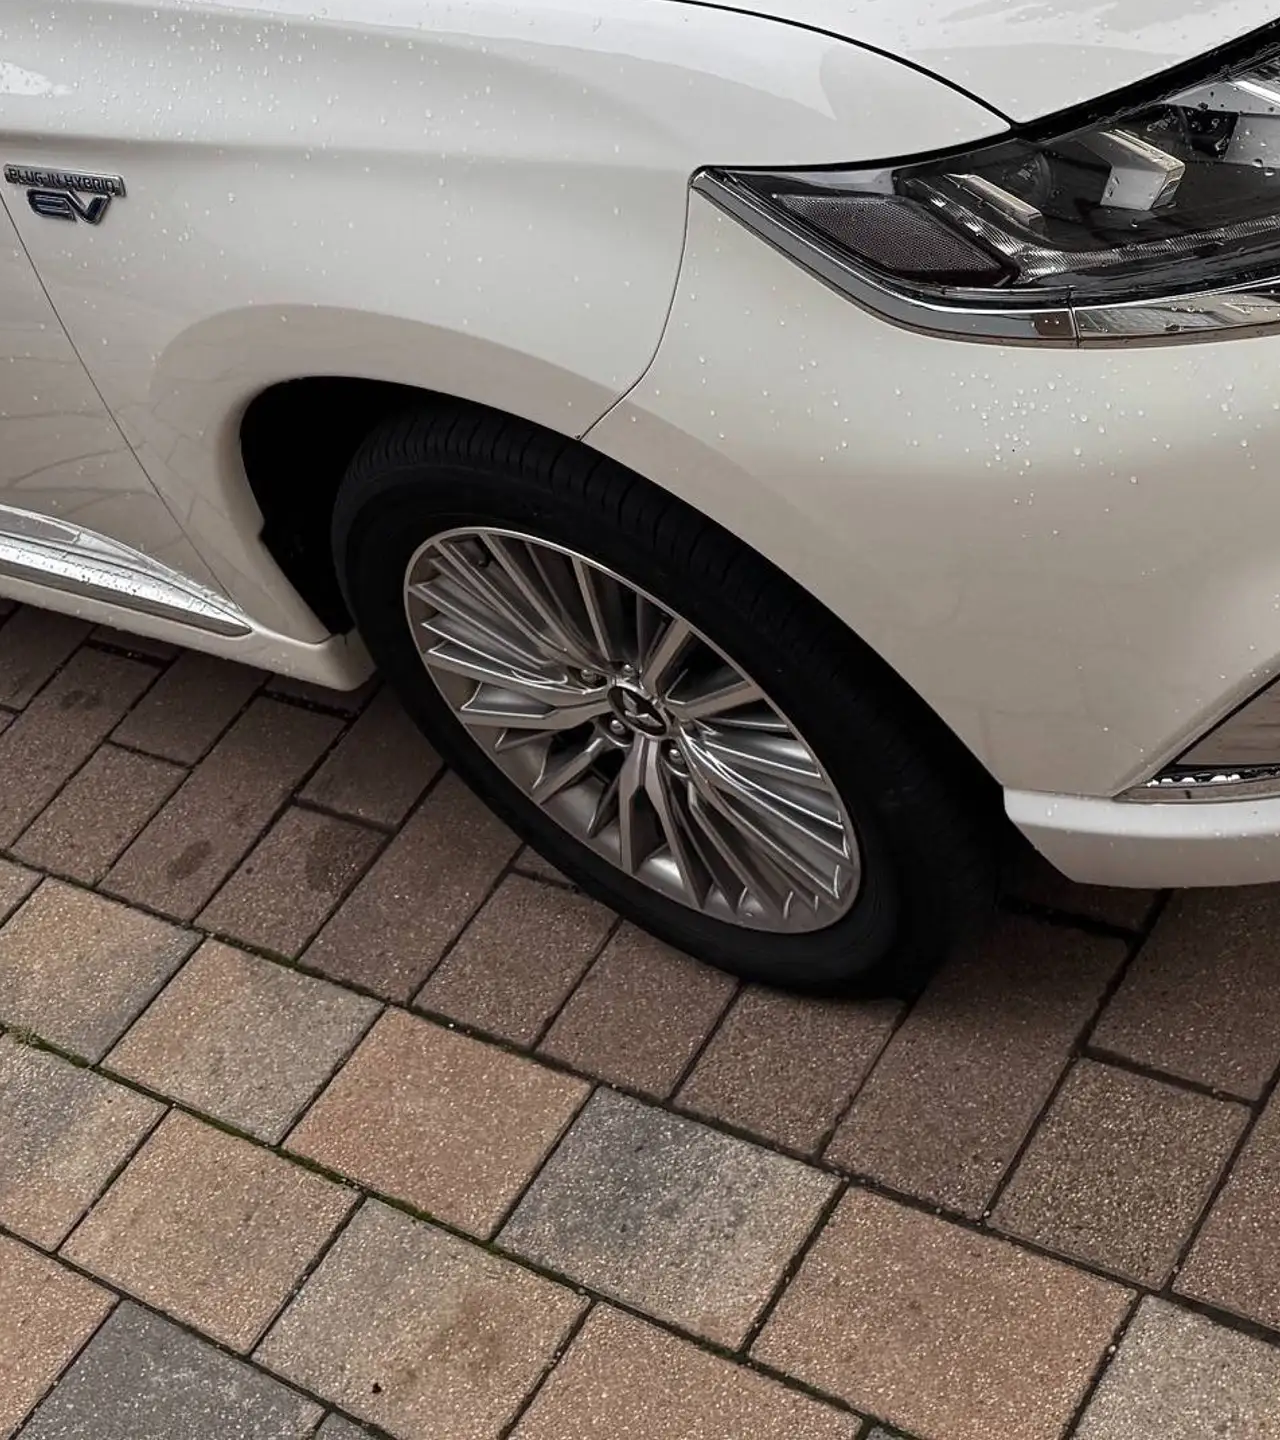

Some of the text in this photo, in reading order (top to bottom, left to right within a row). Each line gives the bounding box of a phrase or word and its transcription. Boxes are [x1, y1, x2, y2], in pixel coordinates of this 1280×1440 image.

[7, 166, 116, 194] PLUG-IN HYBRID
[26, 187, 112, 226] EV
